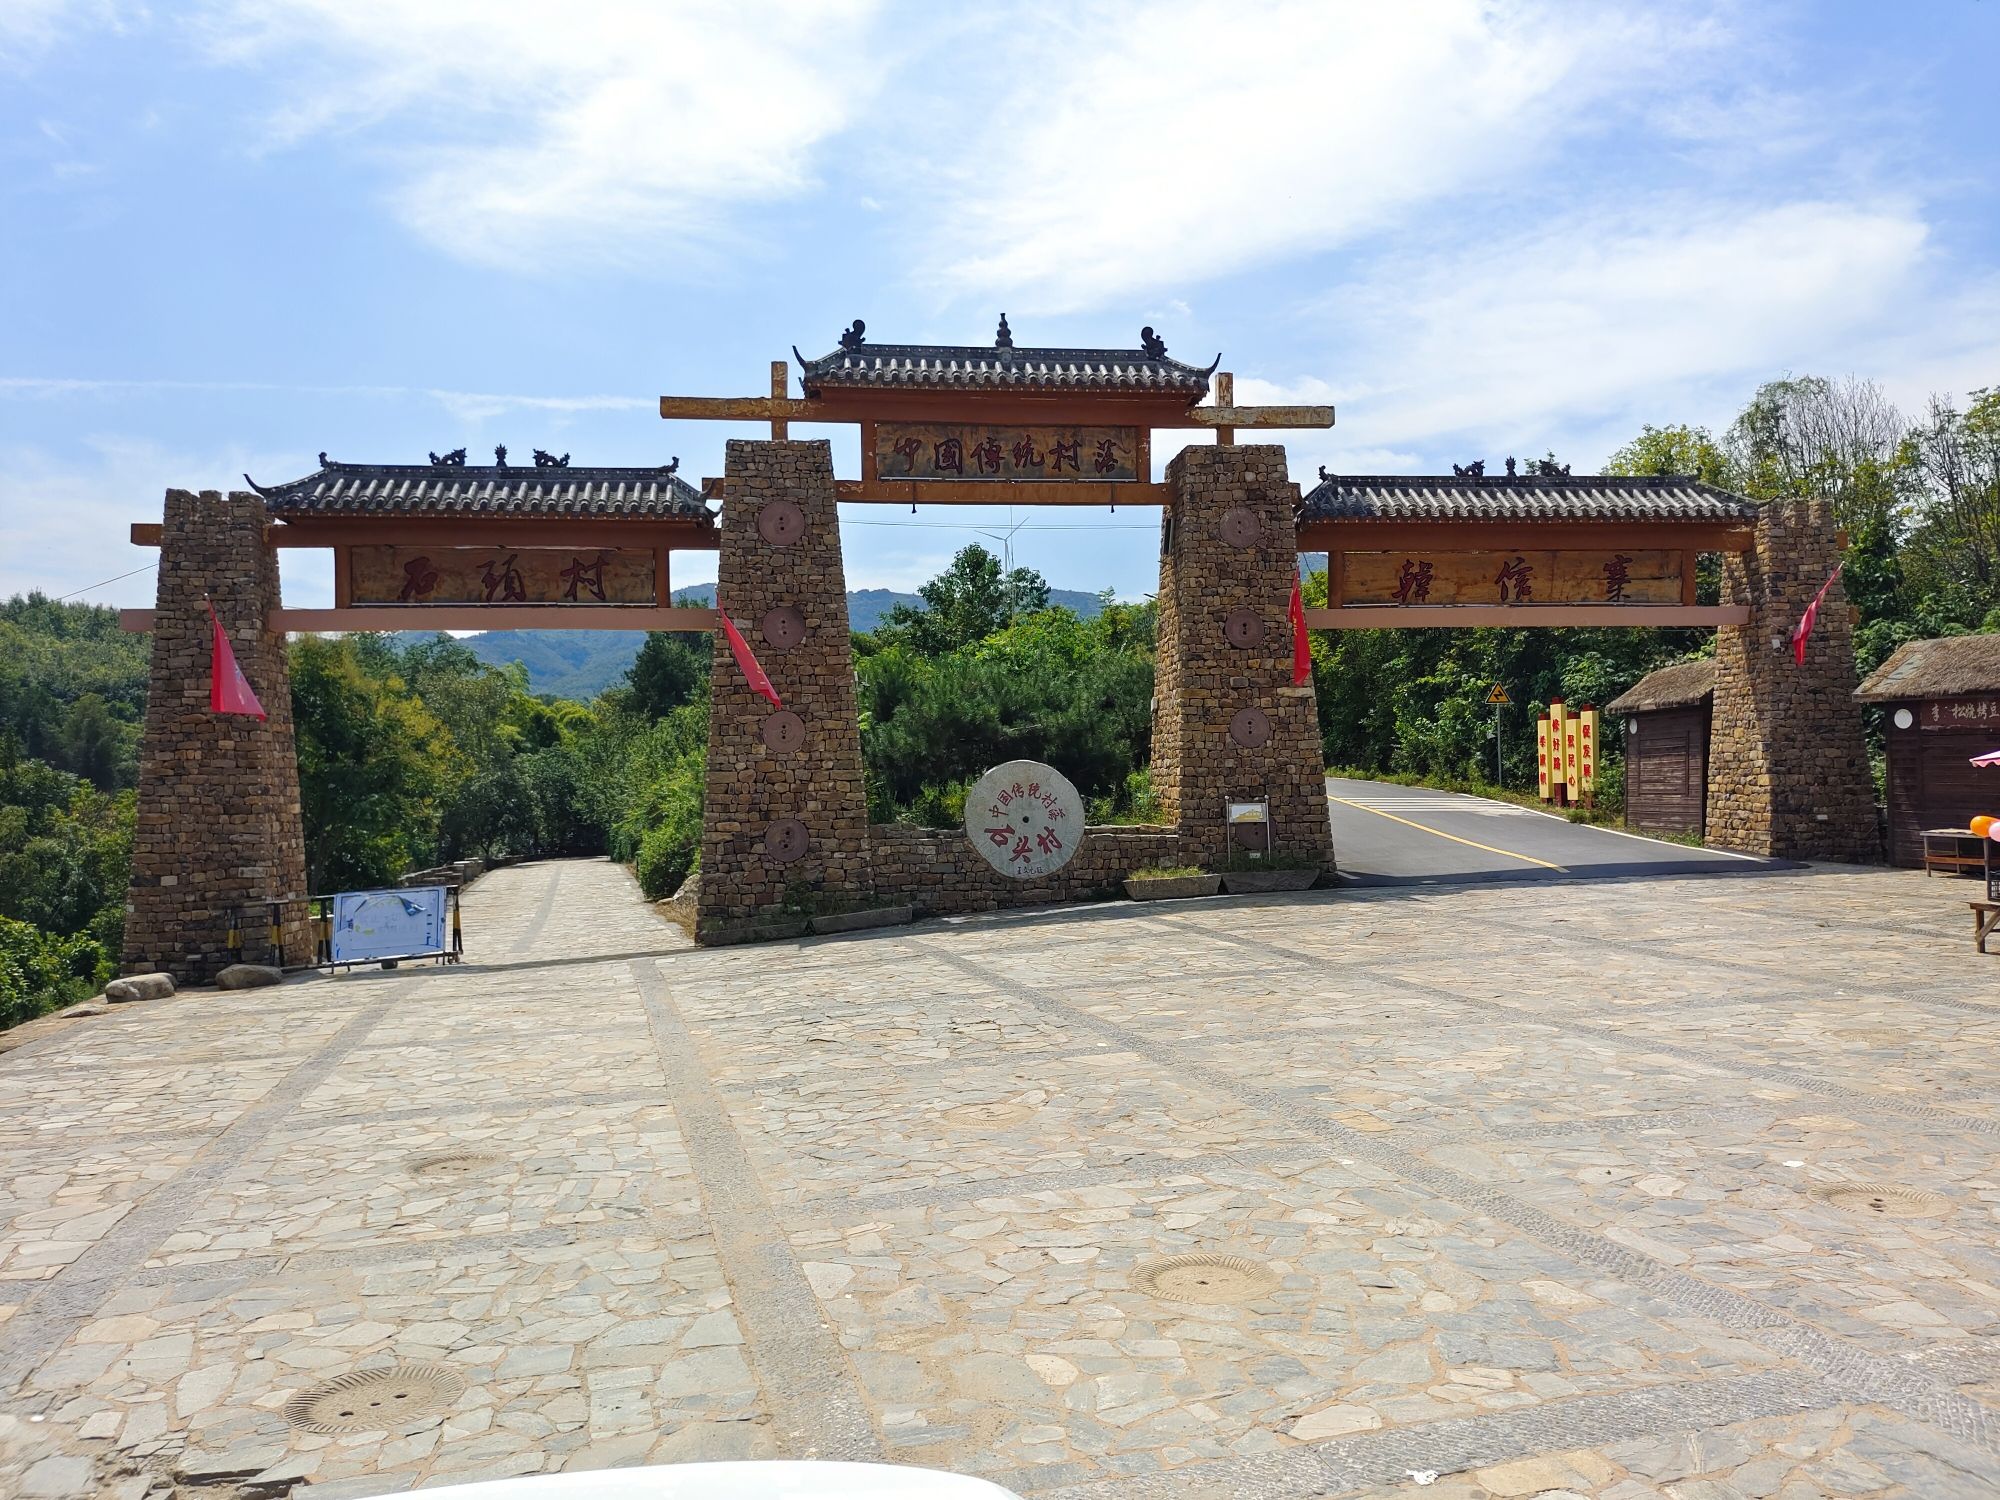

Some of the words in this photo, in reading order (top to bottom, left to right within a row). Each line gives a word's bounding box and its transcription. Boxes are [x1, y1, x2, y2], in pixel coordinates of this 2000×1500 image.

[1567, 734, 1576, 786] 聚民心
[984, 823, 1063, 864] 石头村
